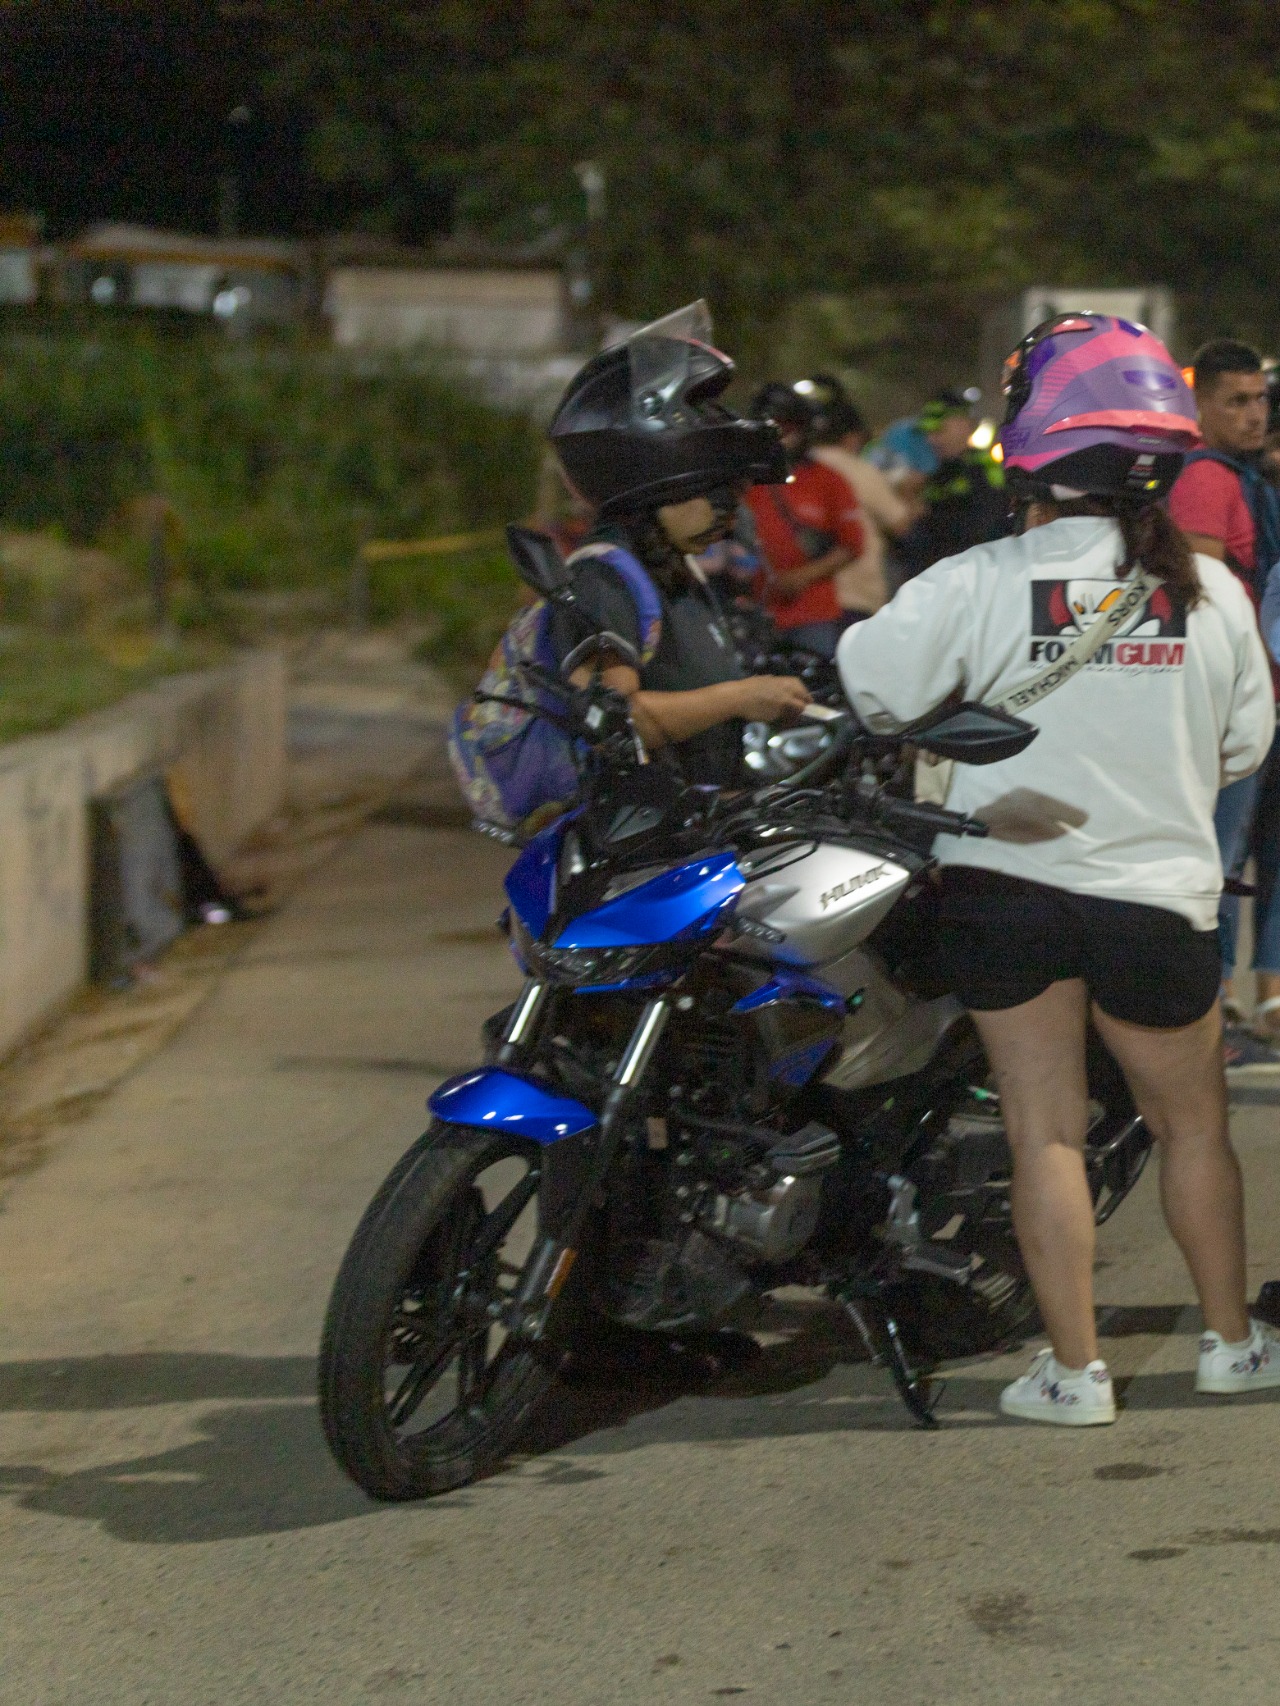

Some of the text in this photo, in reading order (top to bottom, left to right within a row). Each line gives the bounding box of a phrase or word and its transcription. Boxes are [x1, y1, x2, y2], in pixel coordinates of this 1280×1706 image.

[1009, 581, 1146, 705] KORS MICHAEL
[1029, 641, 1186, 666] FOMGUM
